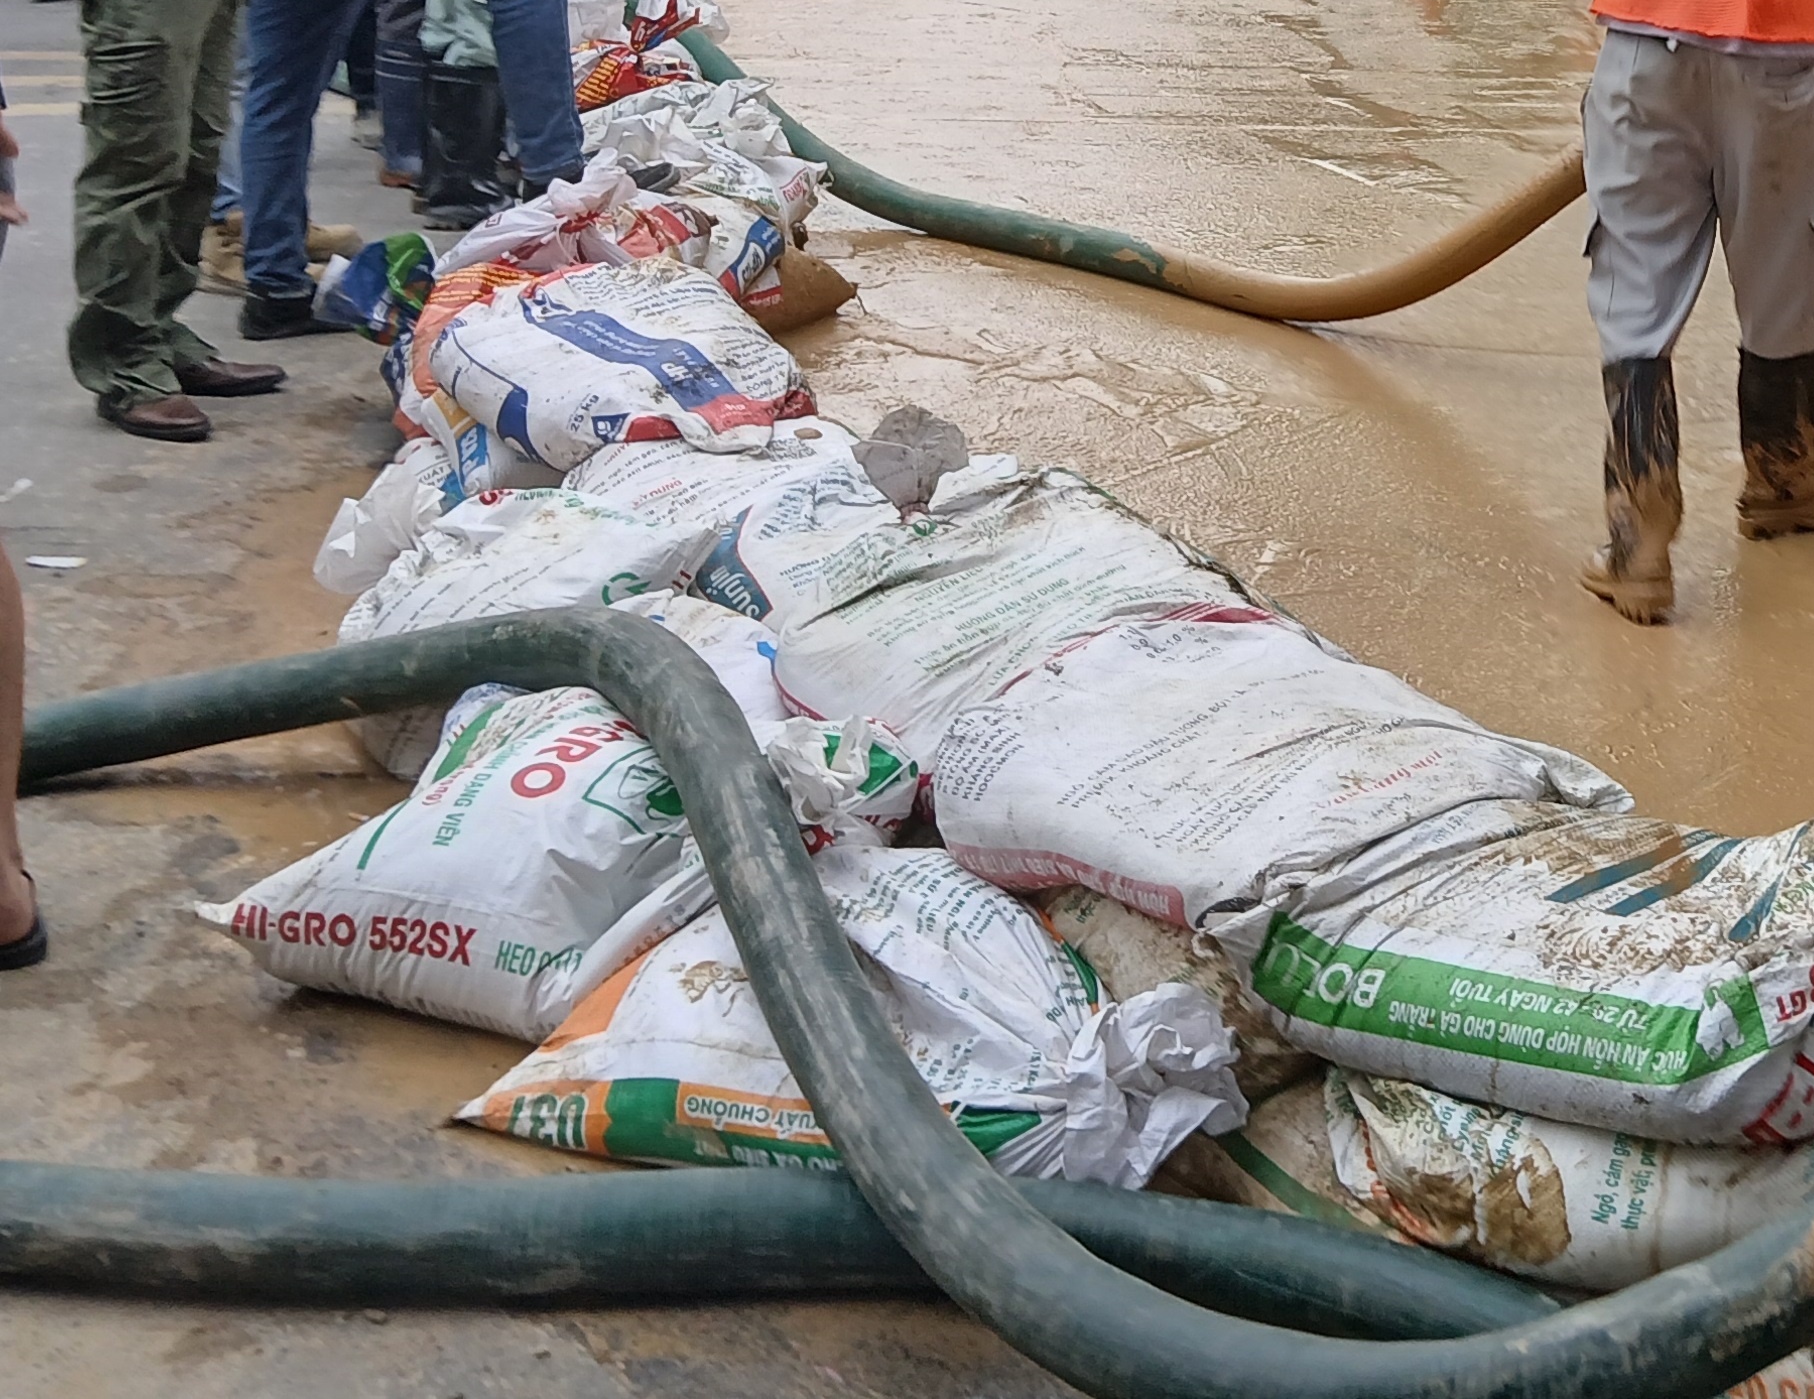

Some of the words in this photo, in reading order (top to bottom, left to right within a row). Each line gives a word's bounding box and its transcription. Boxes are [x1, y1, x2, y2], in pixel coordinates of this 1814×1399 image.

[230, 904, 357, 948] HI-GRO
[369, 914, 478, 967] 552SX
[1448, 976, 1494, 1008] TUỔI
[1493, 987, 1554, 1016] NGÀY
[1439, 1009, 1462, 1038] GÀ
[1462, 1014, 1496, 1041] CHO
[1497, 1021, 1545, 1053] DÙNG
[1547, 1025, 1581, 1056] HỢP
